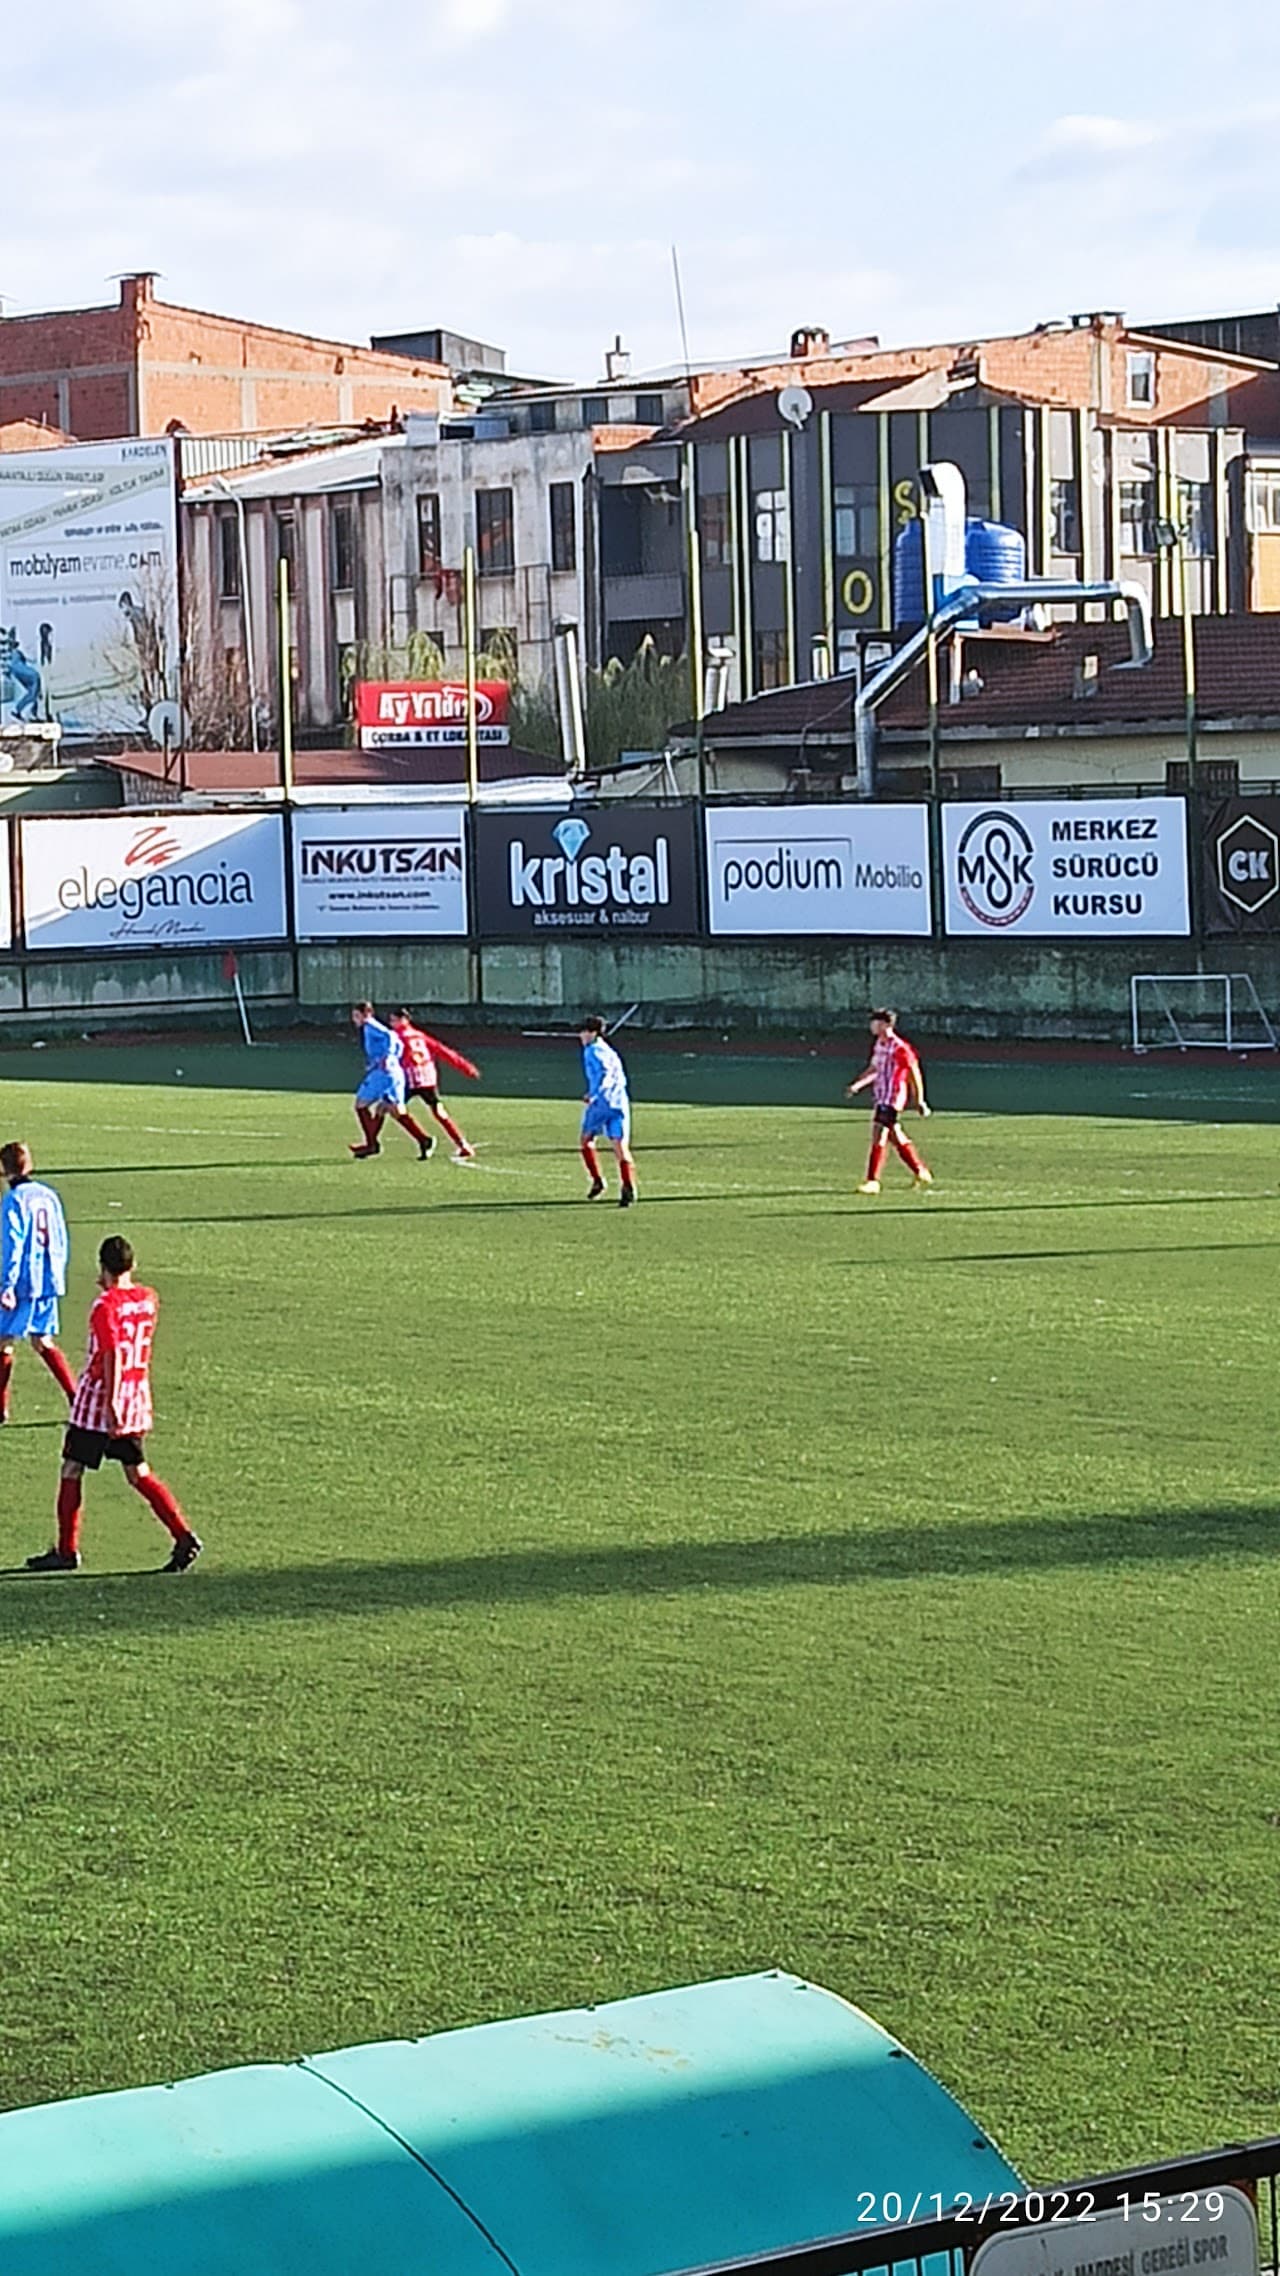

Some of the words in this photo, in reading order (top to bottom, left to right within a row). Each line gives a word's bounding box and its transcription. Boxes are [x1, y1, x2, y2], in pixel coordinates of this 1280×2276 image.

[1052, 818, 1158, 841] MERKEZ
[510, 837, 669, 906] kristal
[724, 847, 842, 902] podium
[958, 828, 1034, 909] MSK
[1052, 852, 1159, 878] SÜRÜCÜ
[1228, 850, 1270, 882] CK
[58, 861, 254, 919] elegancia
[1053, 894, 1143, 916] KURSU
[534, 910, 596, 926] aksesuar
[599, 909, 610, 925] &
[612, 909, 651, 925] nalbur
[1193, 2234, 1229, 2265] SPOR
